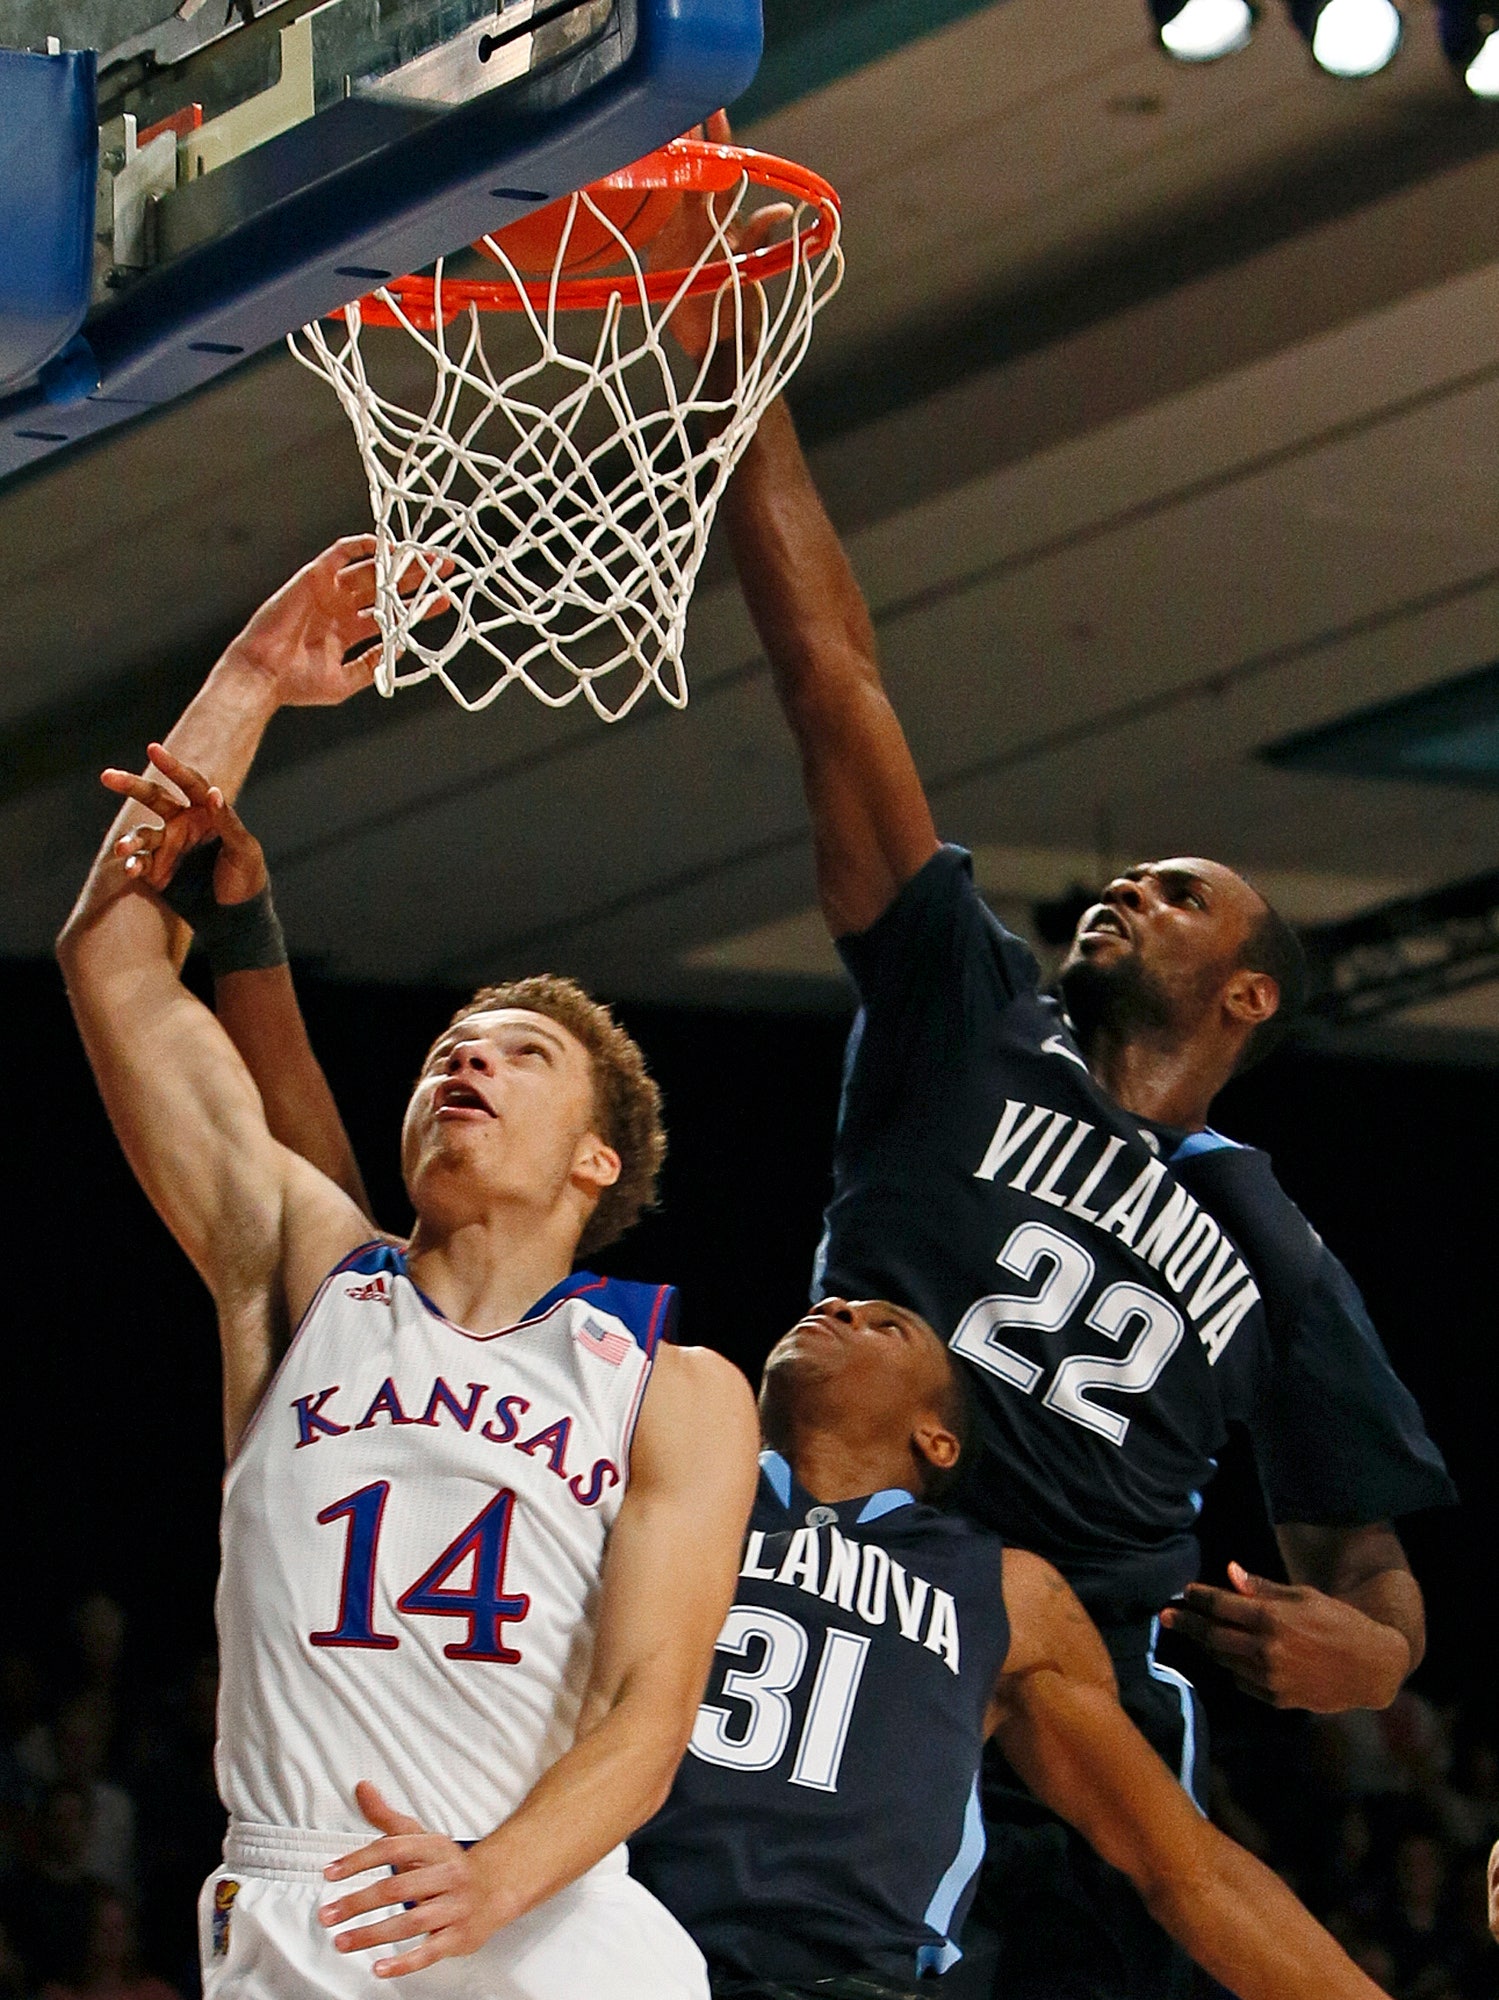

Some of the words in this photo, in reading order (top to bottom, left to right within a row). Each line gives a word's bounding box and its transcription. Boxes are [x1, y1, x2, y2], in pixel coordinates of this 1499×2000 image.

[973, 1099, 1261, 1367] VILLANOVA
[948, 1221, 1185, 1447] 22
[291, 1376, 620, 1506] KANSAS
[309, 1480, 530, 1664] 14
[687, 1604, 871, 1793] 31
